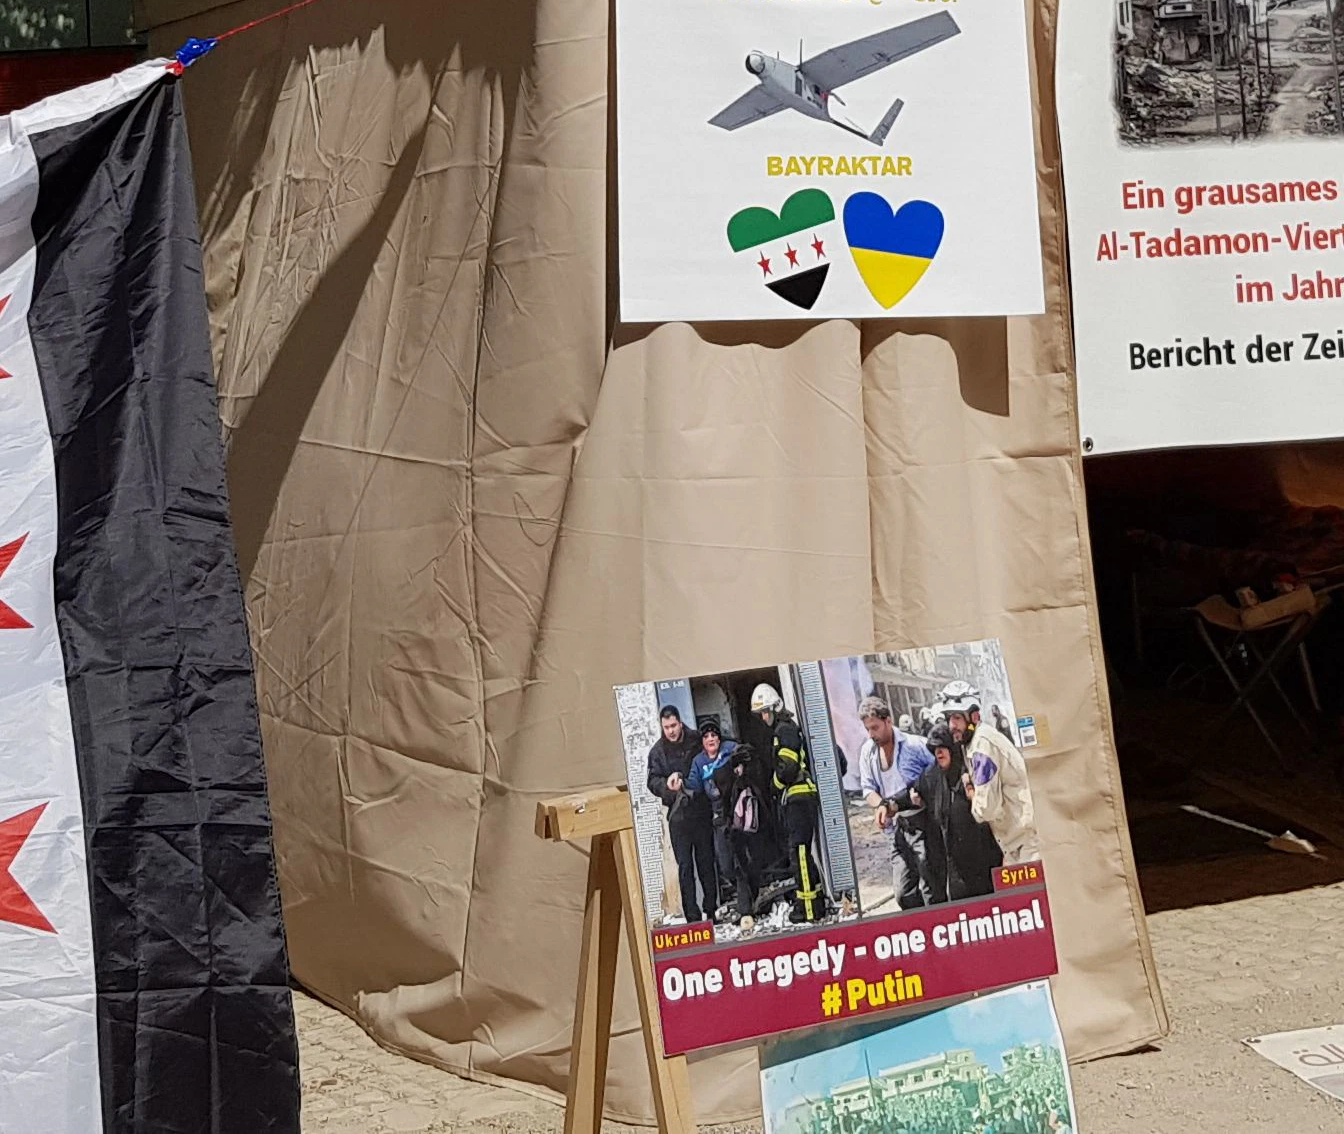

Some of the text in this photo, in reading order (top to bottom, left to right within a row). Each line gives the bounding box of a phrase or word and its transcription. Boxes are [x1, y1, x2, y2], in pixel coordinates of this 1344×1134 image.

[767, 156, 912, 176] BAYRAKTAR
[1122, 180, 1165, 209] Ein
[1174, 179, 1338, 214] grausames
[1236, 274, 1274, 303] im
[1282, 270, 1344, 301] Jahr
[1129, 336, 1236, 370] Bericht
[1246, 334, 1293, 364] der
[1001, 866, 1038, 884] Syria
[655, 927, 711, 949] Ukraine
[662, 967, 723, 1002] One
[730, 940, 846, 988] tragedy
[874, 928, 926, 961] one
[932, 900, 1044, 949] criminal
